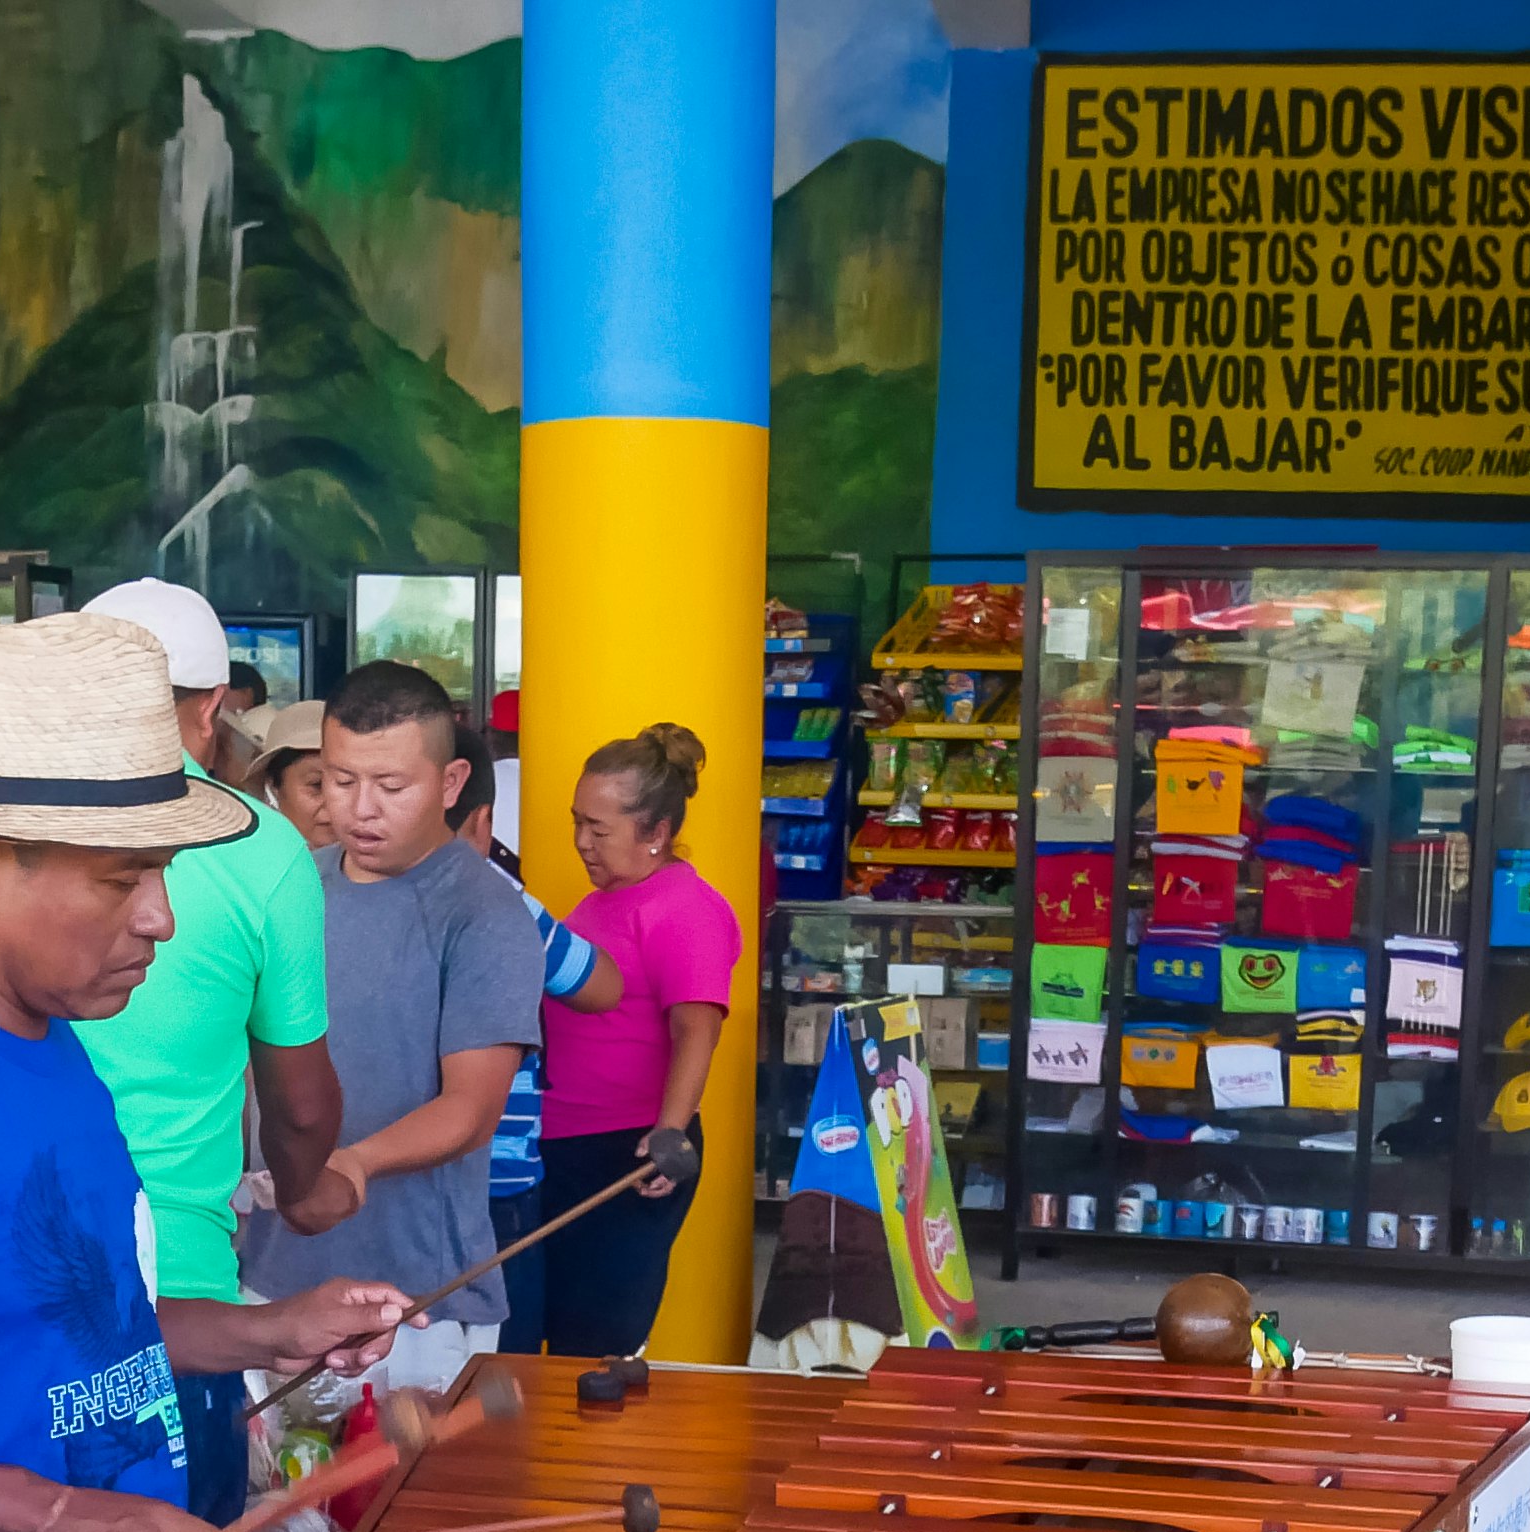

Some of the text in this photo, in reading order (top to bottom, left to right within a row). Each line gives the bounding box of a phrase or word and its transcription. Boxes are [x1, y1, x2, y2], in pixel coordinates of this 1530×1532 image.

[1065, 86, 1404, 161] ESTIMADOS
[1048, 167, 1096, 226] LA
[1105, 167, 1263, 226] EMPRESA
[1271, 168, 1321, 226] NO
[1324, 170, 1366, 227] SE
[1372, 170, 1459, 228] HACE
[1056, 229, 1126, 286] POR
[1140, 230, 1317, 287] OBJETOS
[1362, 231, 1501, 290] COSAS
[1070, 291, 1237, 348] DENTRO
[1244, 293, 1294, 350] DE
[1306, 293, 1374, 351] LA
[1139, 354, 1266, 410] FAVOR
[1281, 356, 1490, 417] VERIFIQUE
[1082, 414, 1151, 471] AL
